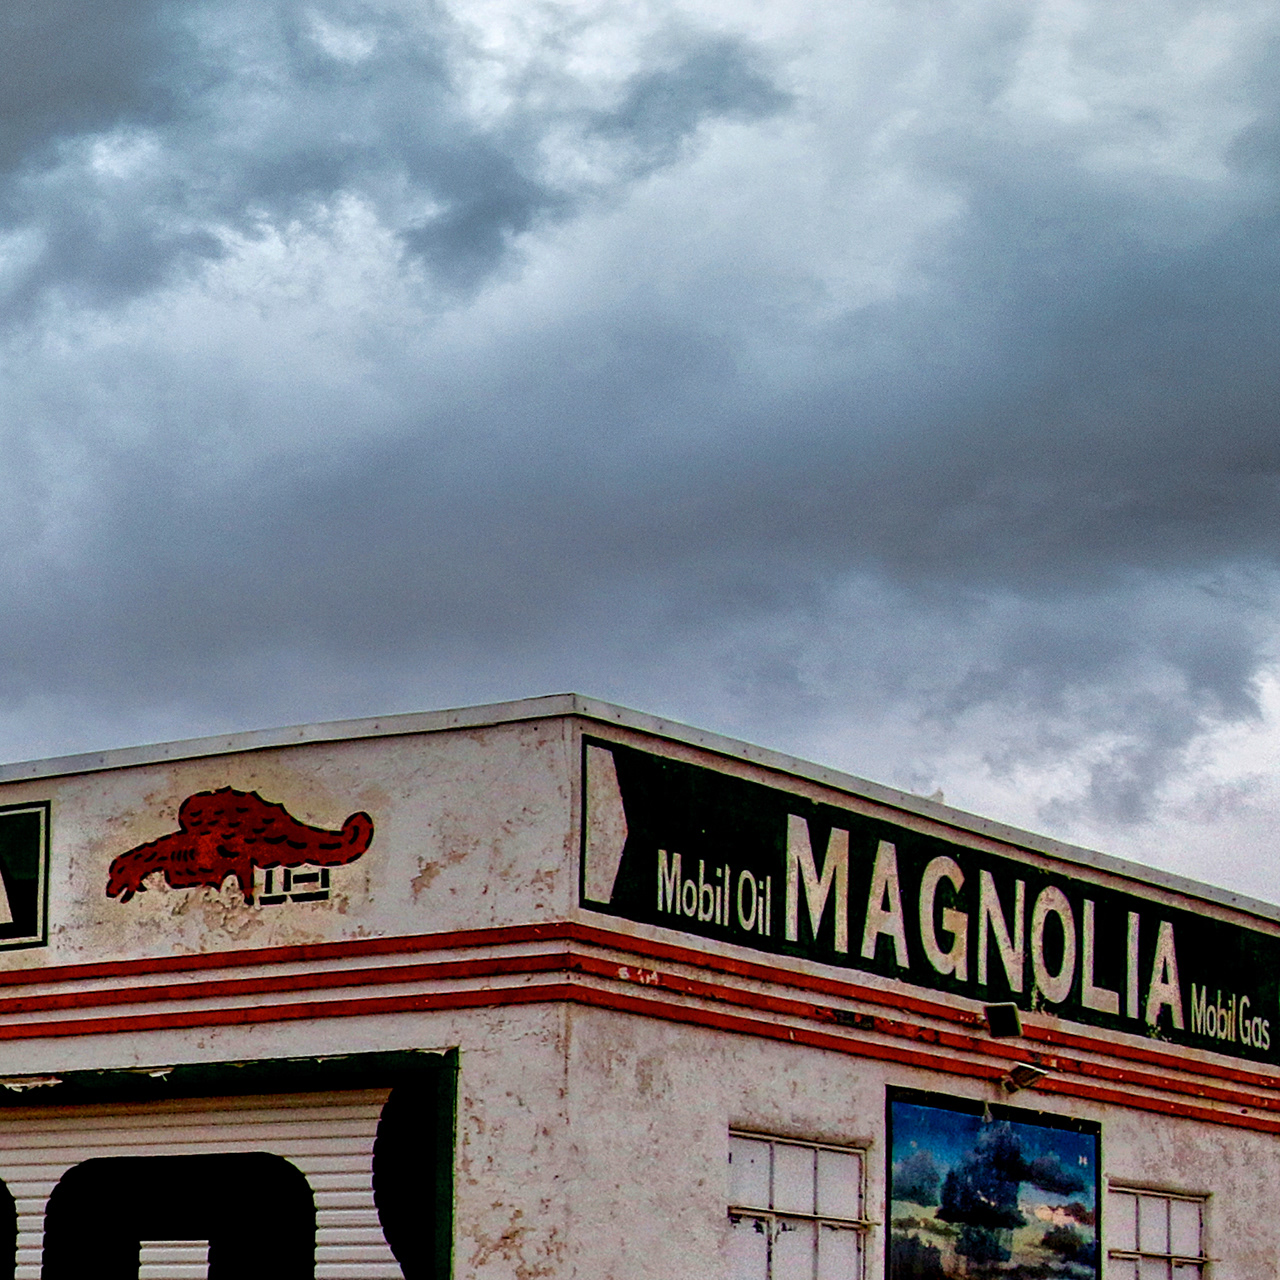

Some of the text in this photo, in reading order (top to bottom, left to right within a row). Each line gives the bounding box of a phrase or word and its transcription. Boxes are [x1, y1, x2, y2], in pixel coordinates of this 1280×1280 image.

[657, 813, 1271, 1050] Mobil Oil MAGNOLIA Mobil Gas
